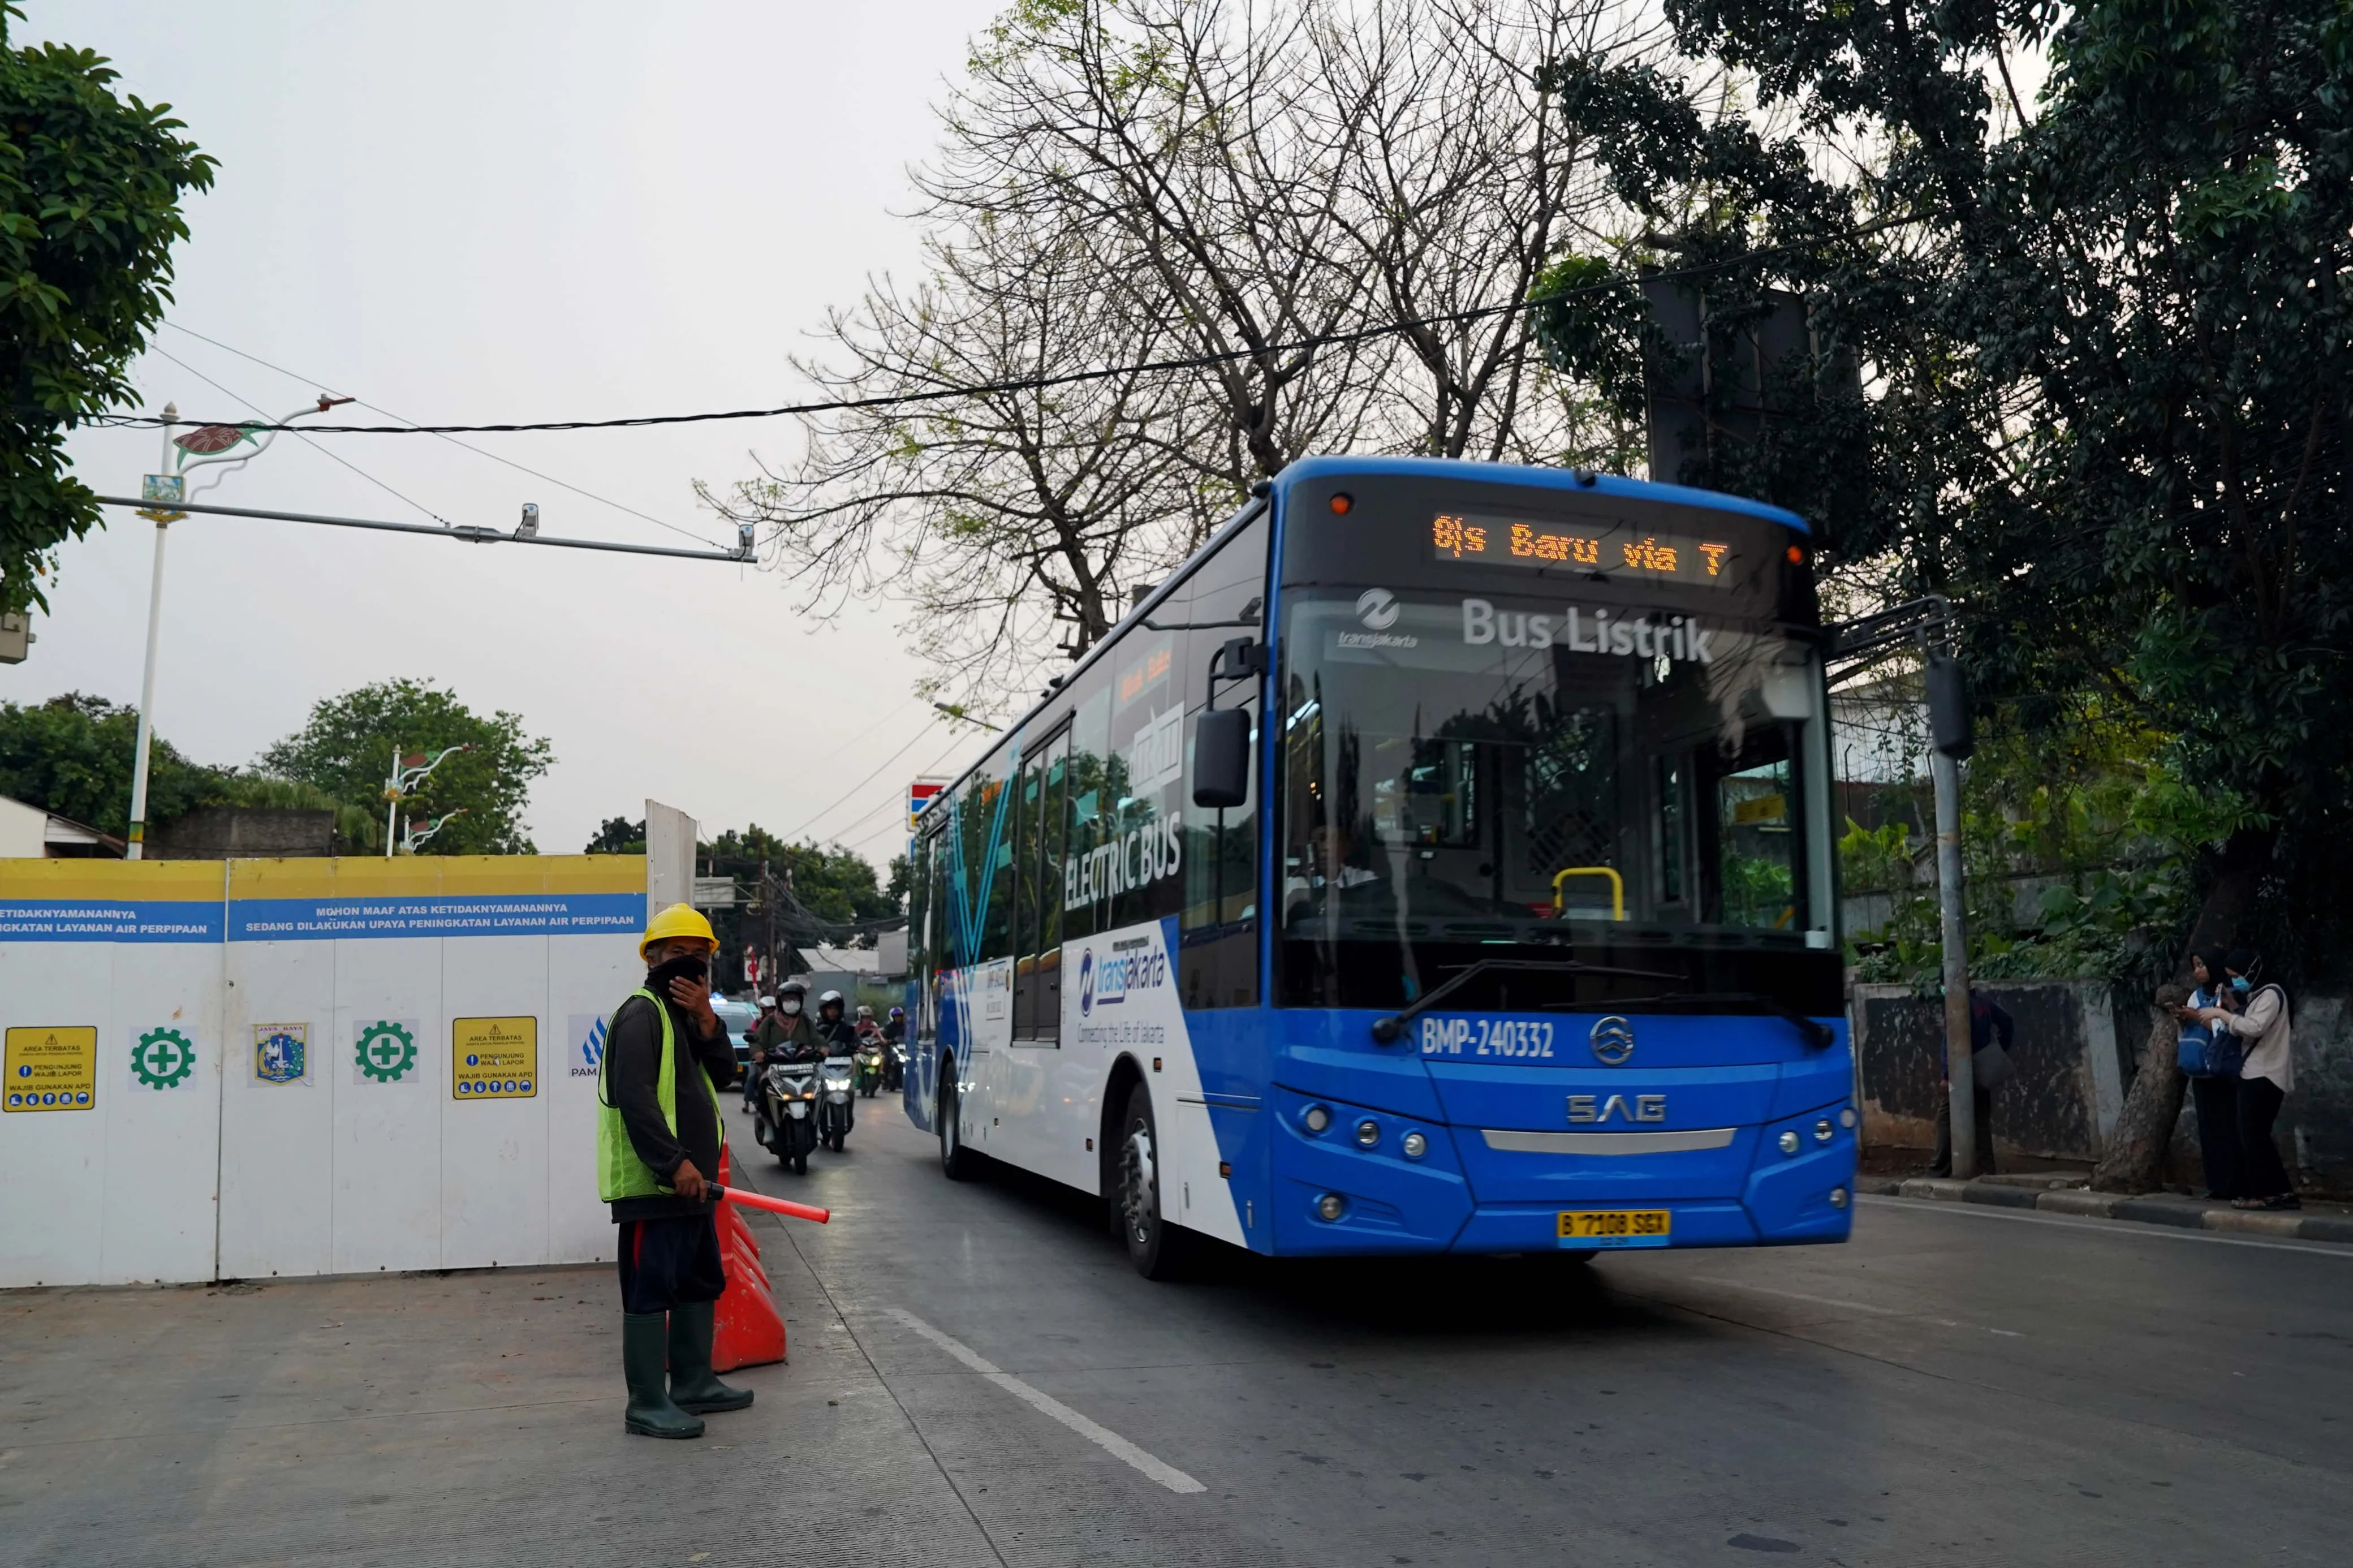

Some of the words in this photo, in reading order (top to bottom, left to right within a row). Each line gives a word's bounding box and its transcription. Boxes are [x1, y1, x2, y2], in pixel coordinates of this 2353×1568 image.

[1511, 524, 1598, 563] Baru
[1623, 537, 1677, 571] via
[1697, 544, 1728, 575] T
[1337, 631, 1419, 649] transjakarta
[1462, 598, 1553, 650] Bus
[1567, 606, 1714, 664] Listrik
[1065, 830, 1136, 911] ELECTRIC
[1140, 811, 1182, 886] BUS
[316, 907, 360, 916] MOHON
[363, 906, 395, 915] MAAF
[399, 906, 428, 914] ATAS
[430, 903, 568, 914] KETIDAKNYAMANANNYA
[56, 923, 113, 933] LAYANAN
[116, 925, 137, 933] AIR
[140, 925, 207, 934] PERPIPAAN
[245, 922, 294, 932] SEDANG
[298, 920, 365, 931] DILAKUKAN
[369, 920, 406, 929] UPAYA
[409, 917, 490, 928] PENINGKATAN
[494, 917, 546, 927] LAYANAN
[549, 916, 568, 925] AIR
[572, 916, 634, 925] PERPIPAAN
[1097, 945, 1165, 1005] transjakarta
[1421, 1018, 1554, 1057] BMP-240332
[571, 1068, 597, 1076] PAM
[1567, 1093, 1667, 1123] SAG
[1562, 1214, 1574, 1235] B
